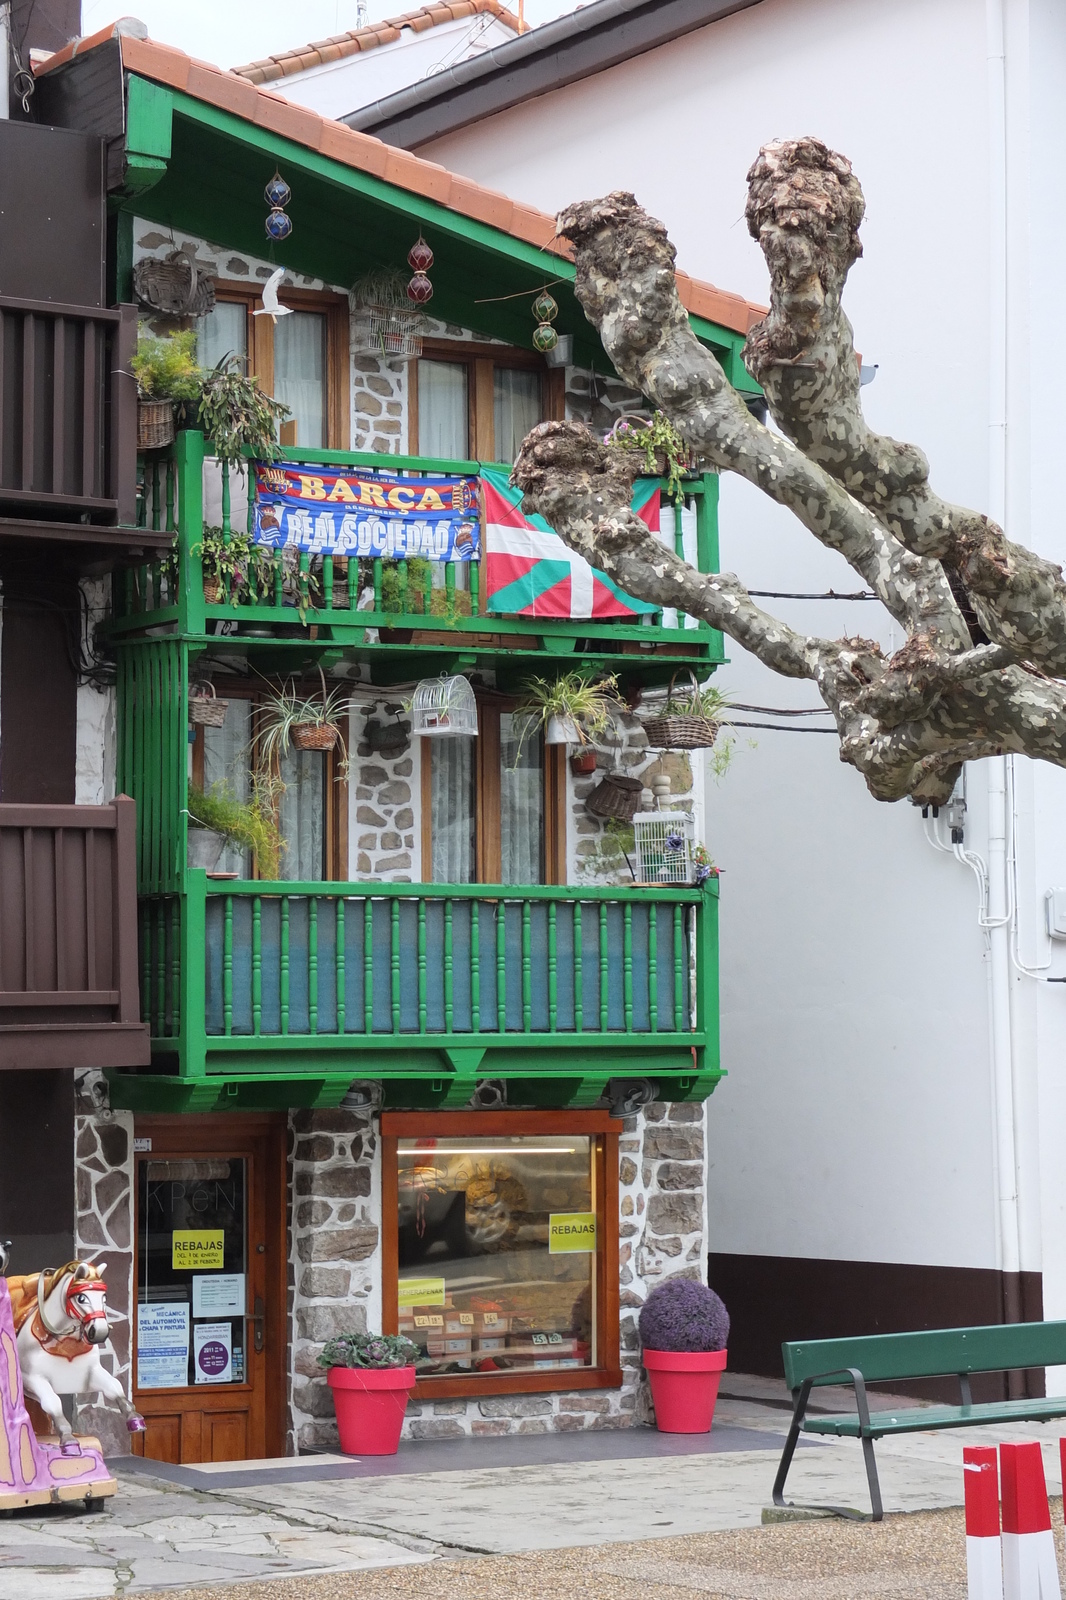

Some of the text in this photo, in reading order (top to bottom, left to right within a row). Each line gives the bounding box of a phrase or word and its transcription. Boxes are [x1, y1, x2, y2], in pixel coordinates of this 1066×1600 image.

[298, 475, 446, 515] BARÇA
[286, 513, 449, 555] REAL SOCIEDAD
[551, 1224, 596, 1235] REBAJAS
[174, 1240, 223, 1251] REBAJAS
